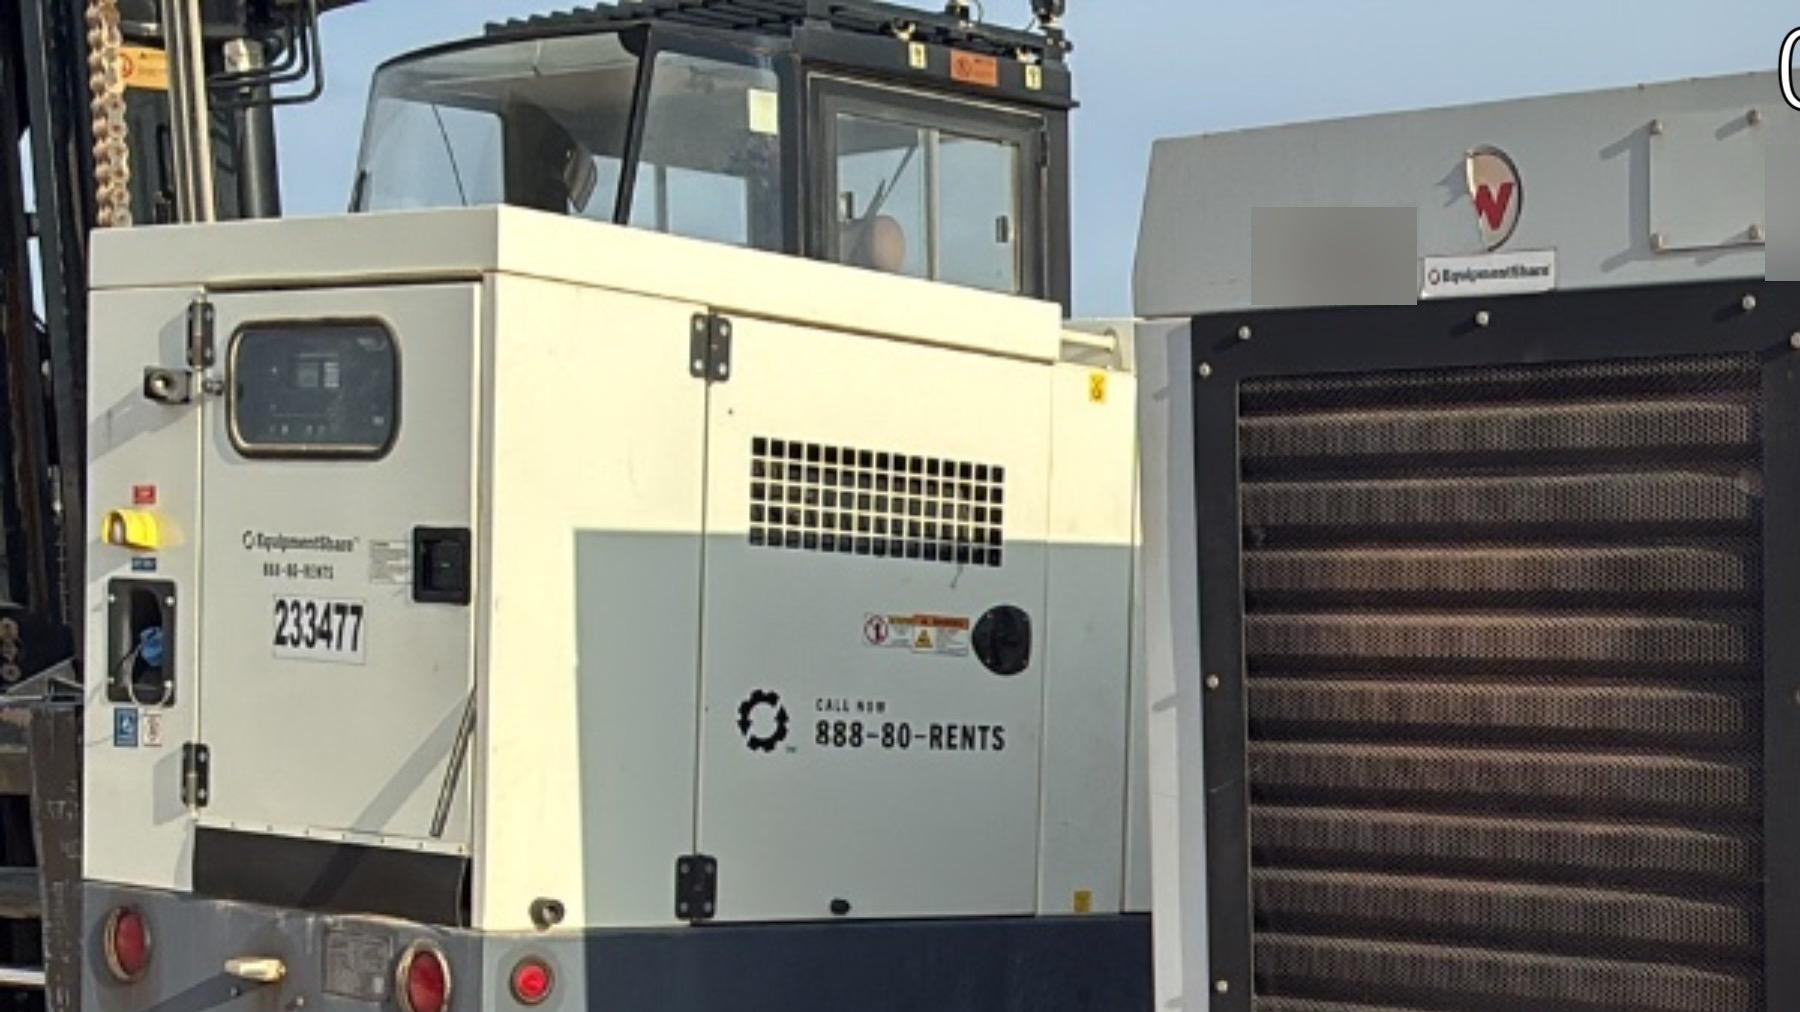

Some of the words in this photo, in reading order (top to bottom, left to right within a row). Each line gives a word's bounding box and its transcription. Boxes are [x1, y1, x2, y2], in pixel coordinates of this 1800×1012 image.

[1443, 264, 1549, 285] EquipmentShare
[257, 532, 354, 553] EquipmentShare
[273, 599, 363, 651] 233477
[816, 698, 850, 713] CALL
[816, 719, 1005, 751] 888-80-RENTS
